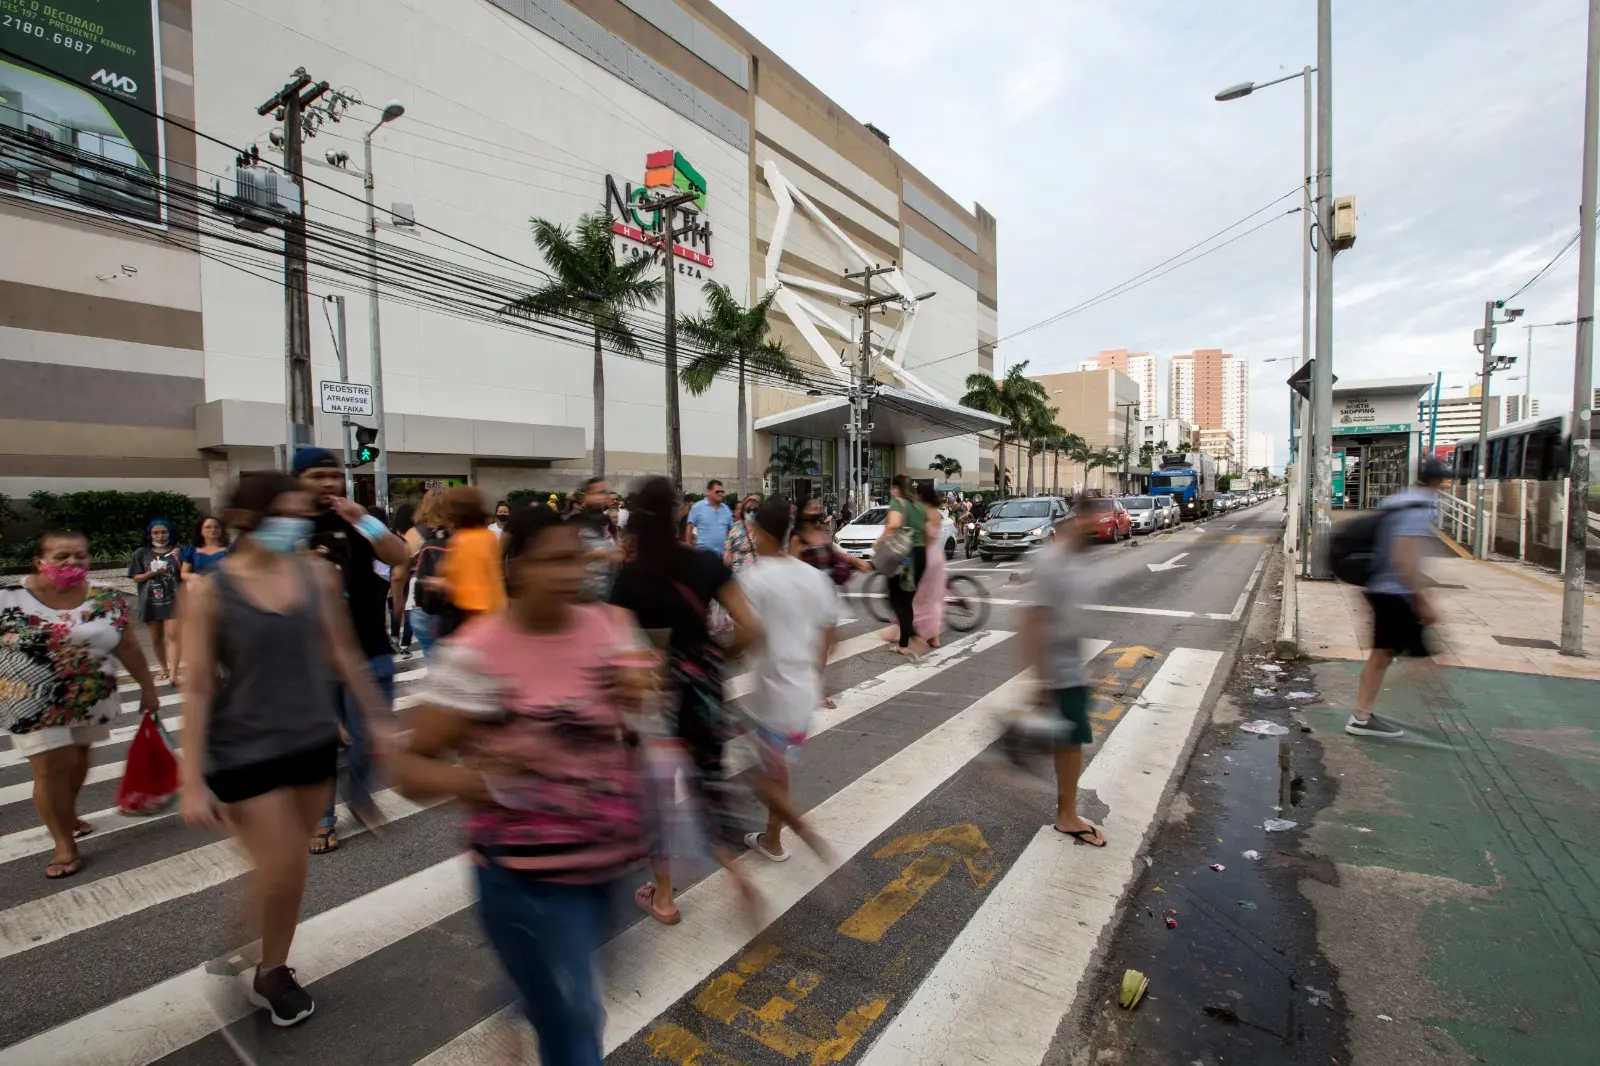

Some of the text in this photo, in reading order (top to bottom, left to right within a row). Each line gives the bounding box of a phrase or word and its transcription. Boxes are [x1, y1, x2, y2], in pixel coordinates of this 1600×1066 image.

[44, 5, 104, 35] DECORADO
[3, 14, 94, 55] 2180.6887
[22, 8, 37, 19] 197
[49, 18, 99, 43] PRESIDENTE
[101, 37, 137, 56] KENNEDY
[324, 384, 369, 395] PEDESTRE
[327, 395, 368, 404] ATRAVESSE
[343, 405, 364, 413] FAIXA
[1340, 407, 1375, 415] SHOPPING
